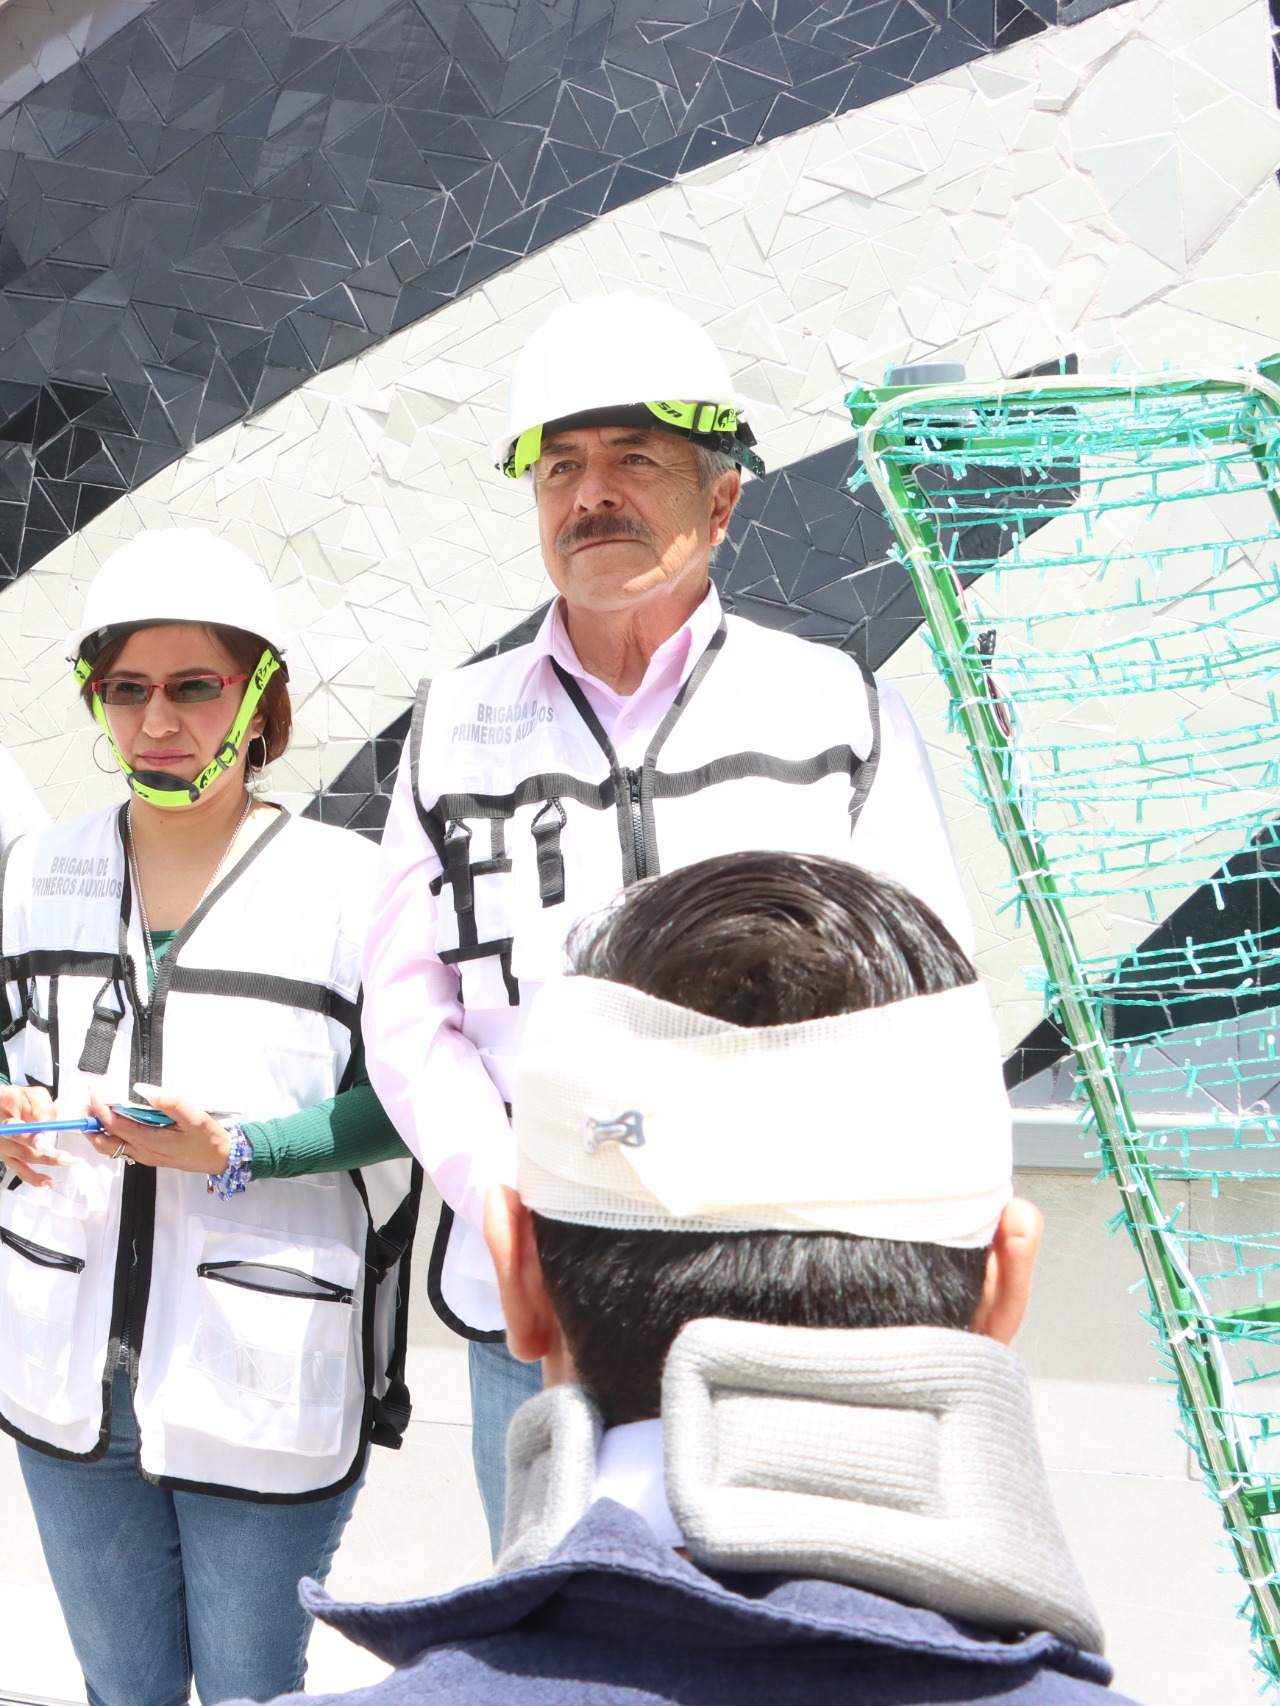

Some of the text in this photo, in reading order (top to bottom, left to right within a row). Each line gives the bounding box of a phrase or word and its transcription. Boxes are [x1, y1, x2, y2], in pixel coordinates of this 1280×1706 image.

[477, 702, 527, 724] BRIGADA
[451, 723, 512, 745] PRIMEROS
[50, 856, 110, 876] BRIGADA DE
[31, 876, 123, 899] PRIMEROS AUXILIOS
